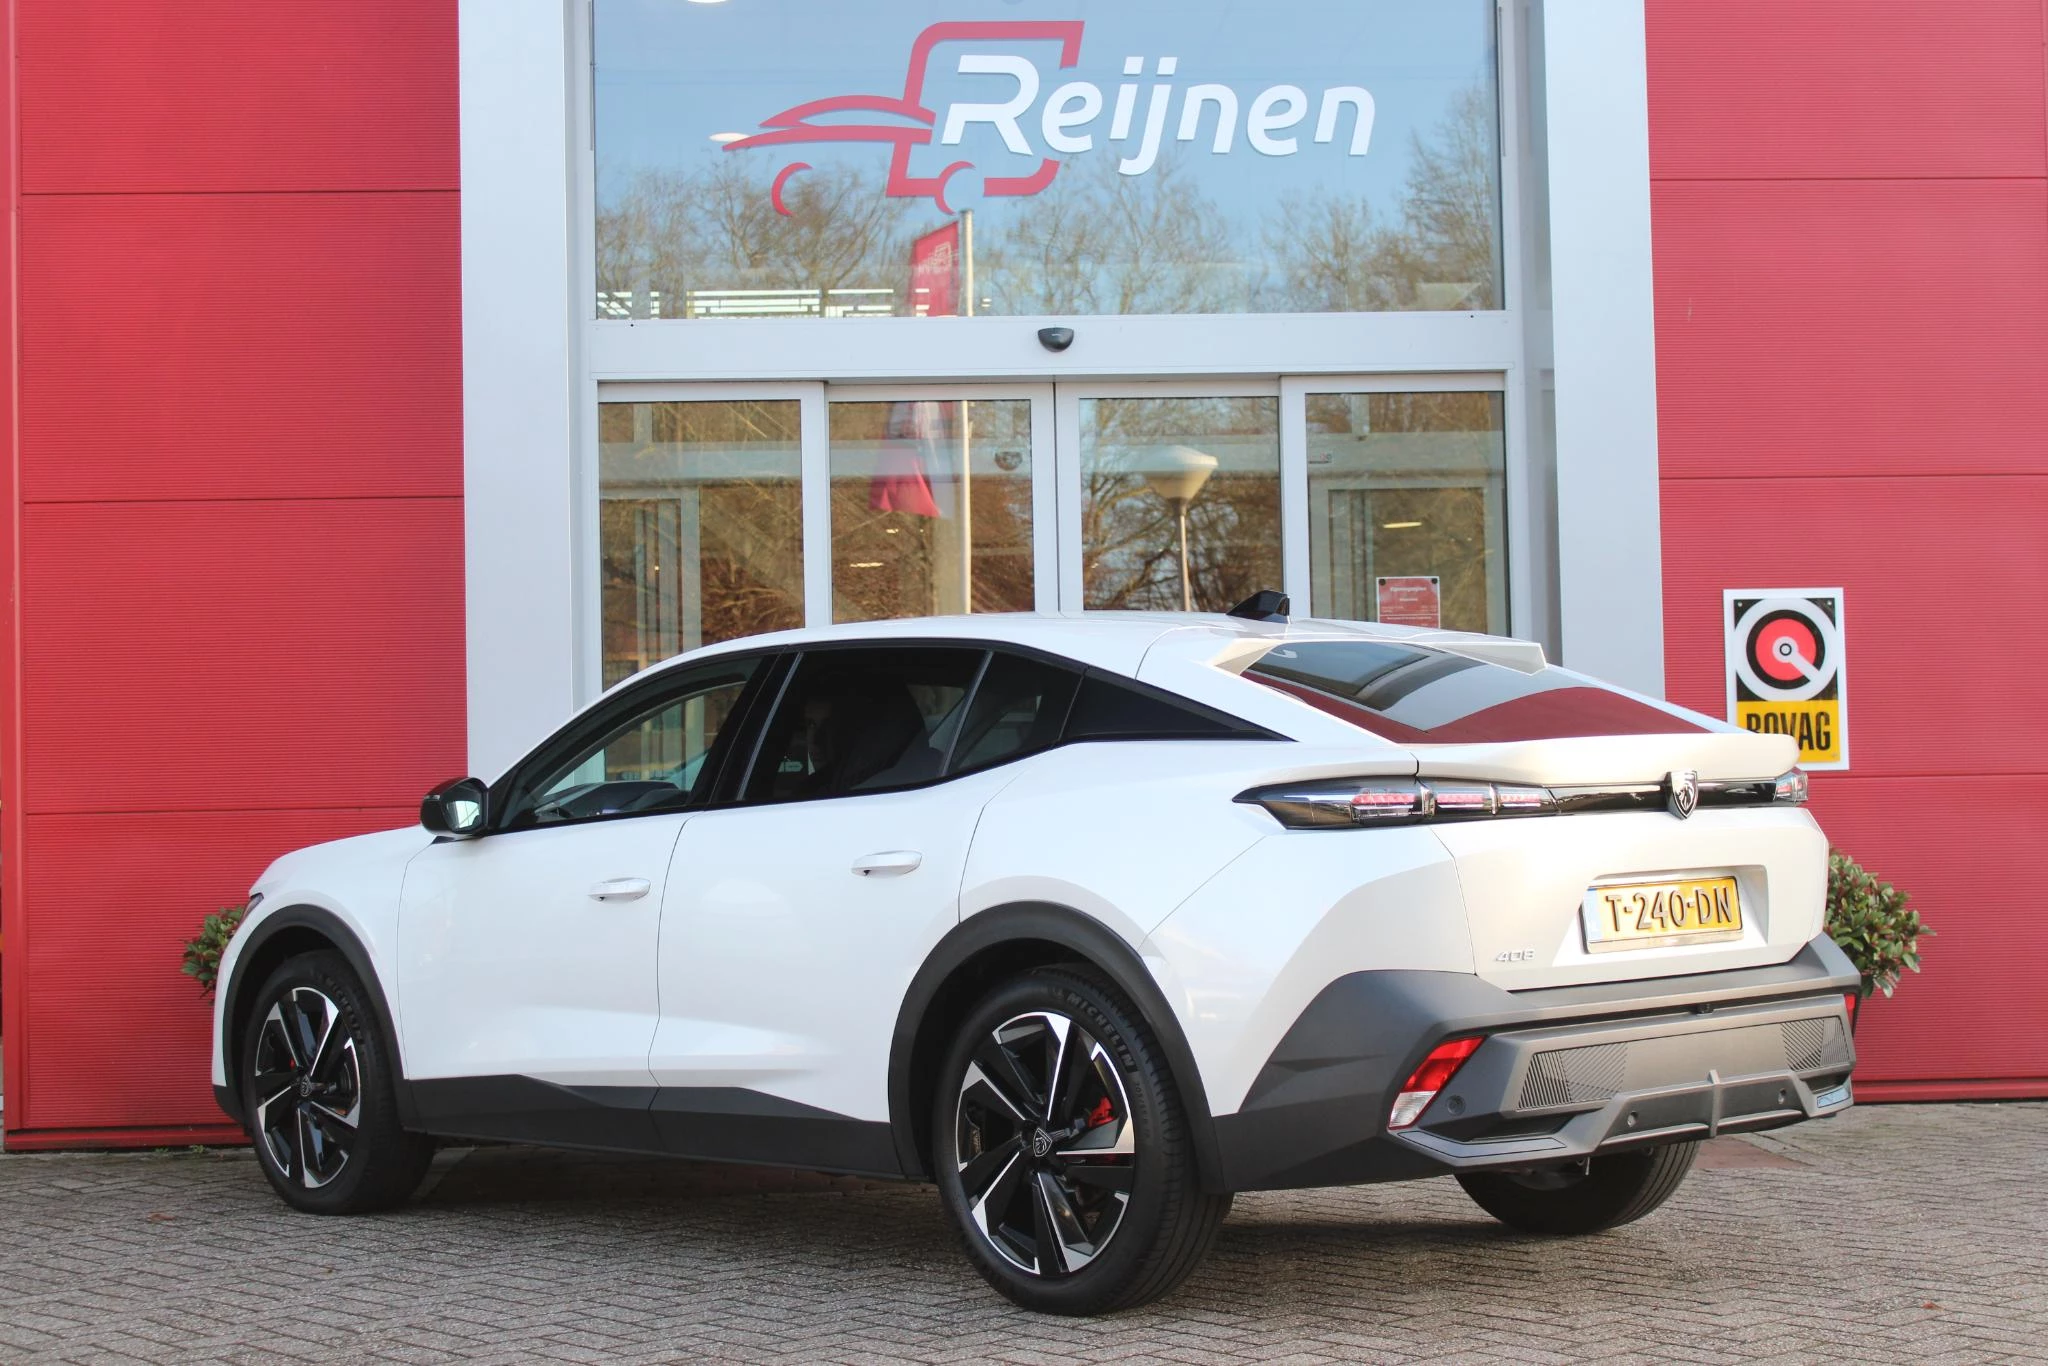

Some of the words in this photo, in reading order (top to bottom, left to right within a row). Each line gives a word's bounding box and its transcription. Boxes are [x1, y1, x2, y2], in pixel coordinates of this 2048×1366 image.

[941, 55, 1376, 176] Reijnen
[1606, 886, 1733, 932] T-240-DN
[1067, 992, 1136, 1066] MICHELIN
